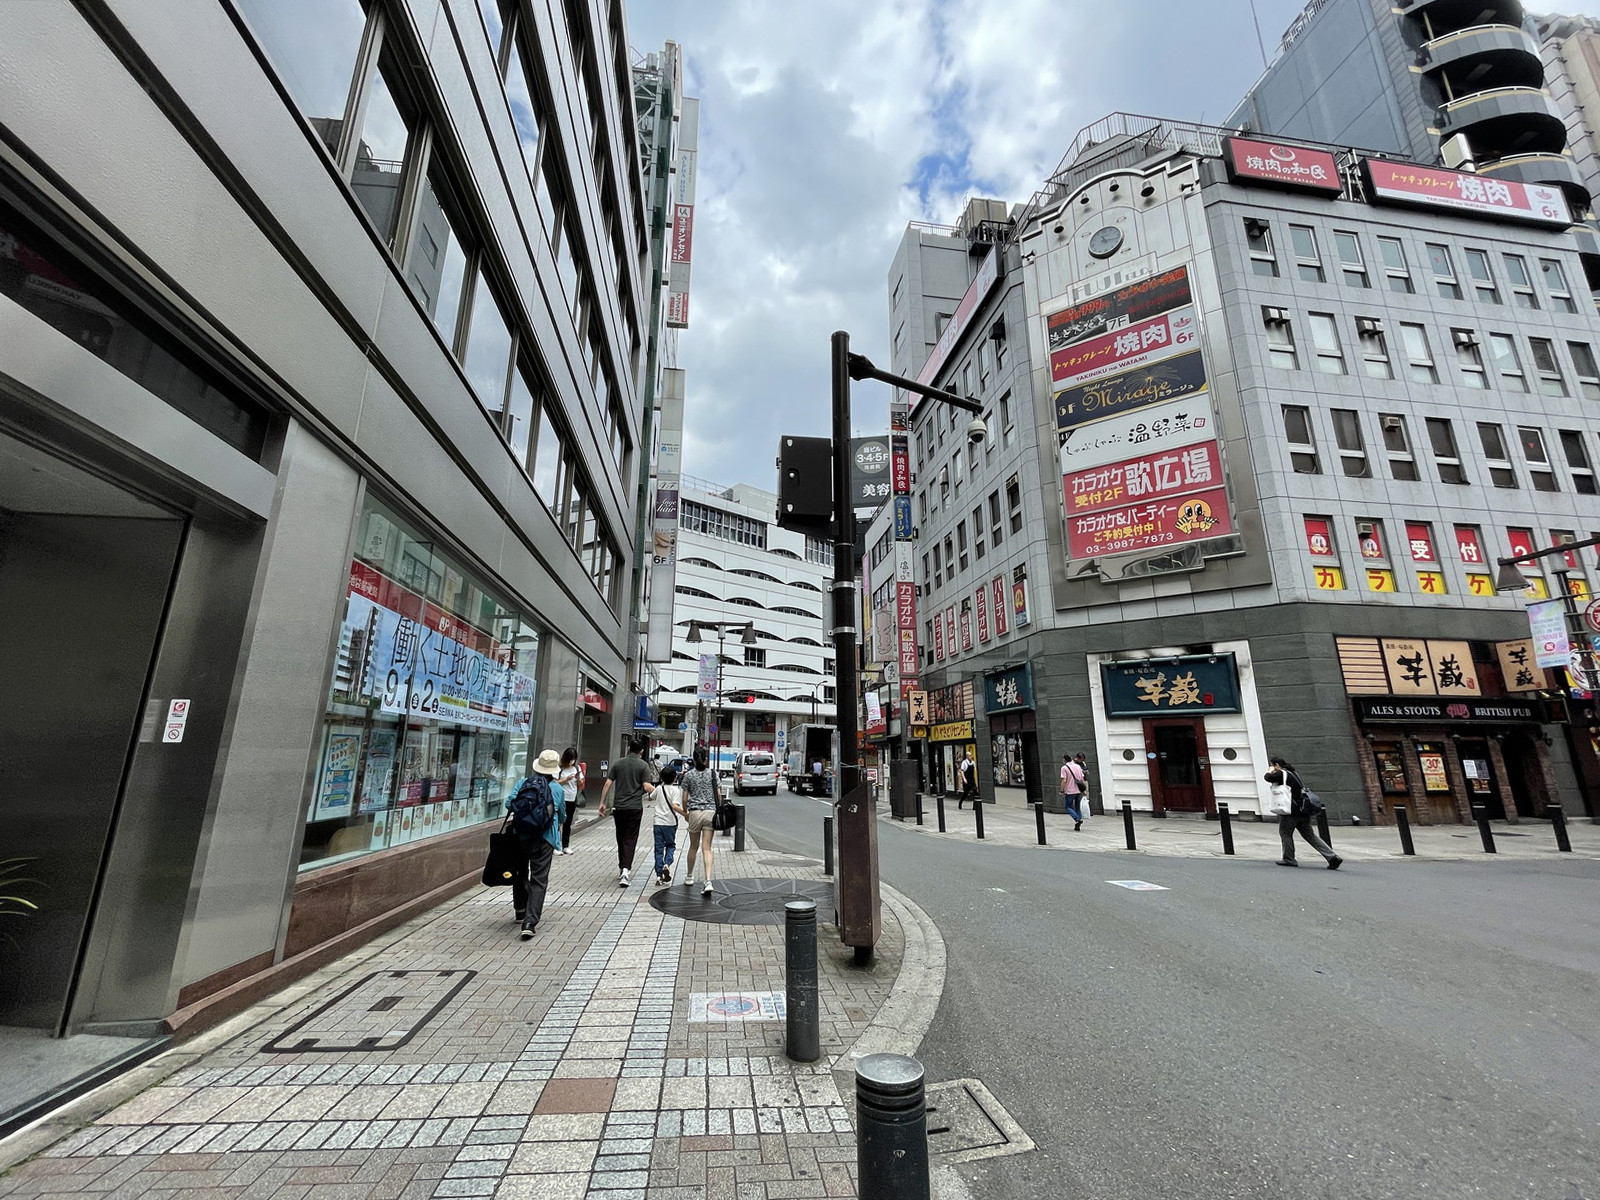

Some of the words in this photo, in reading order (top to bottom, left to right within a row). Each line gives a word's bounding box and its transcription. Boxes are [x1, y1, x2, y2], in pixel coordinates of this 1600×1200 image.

[1246, 155, 1327, 181] 焼肉の和民
[1457, 174, 1514, 206] 焼肉
[1541, 205, 1559, 220] 6F
[1072, 270, 1123, 302] FUJI
[1108, 316, 1127, 331] 7F
[1114, 323, 1167, 357] 焼肉
[1175, 332, 1195, 345] 6F
[1076, 367, 1108, 382] YAKINIKU
[1119, 355, 1148, 369] WATAMI
[1082, 380, 1172, 413] Mirage
[1158, 384, 1194, 398] ミラージュ
[1128, 413, 1192, 444] 温野菜
[1072, 468, 1124, 494] カラオケ
[1124, 447, 1213, 496] 歌広場
[863, 483, 890, 498] 美容
[1074, 487, 1124, 508] 受付2F
[656, 503, 677, 513] hair
[1076, 504, 1177, 534] カラオケ&パーティー
[1086, 532, 1175, 554] 03-3987-7873
[653, 555, 667, 565] 6F
[899, 585, 914, 626] カラオケ
[977, 590, 987, 641] カラオケ
[994, 578, 1004, 630] パーティー
[901, 641, 916, 673] 歌広場
[1370, 706, 1394, 716] ALES
[1396, 706, 1403, 715] &
[1404, 706, 1441, 716] STOUTS
[1474, 707, 1511, 717] BRITISH
[1512, 708, 1532, 718] PUB
